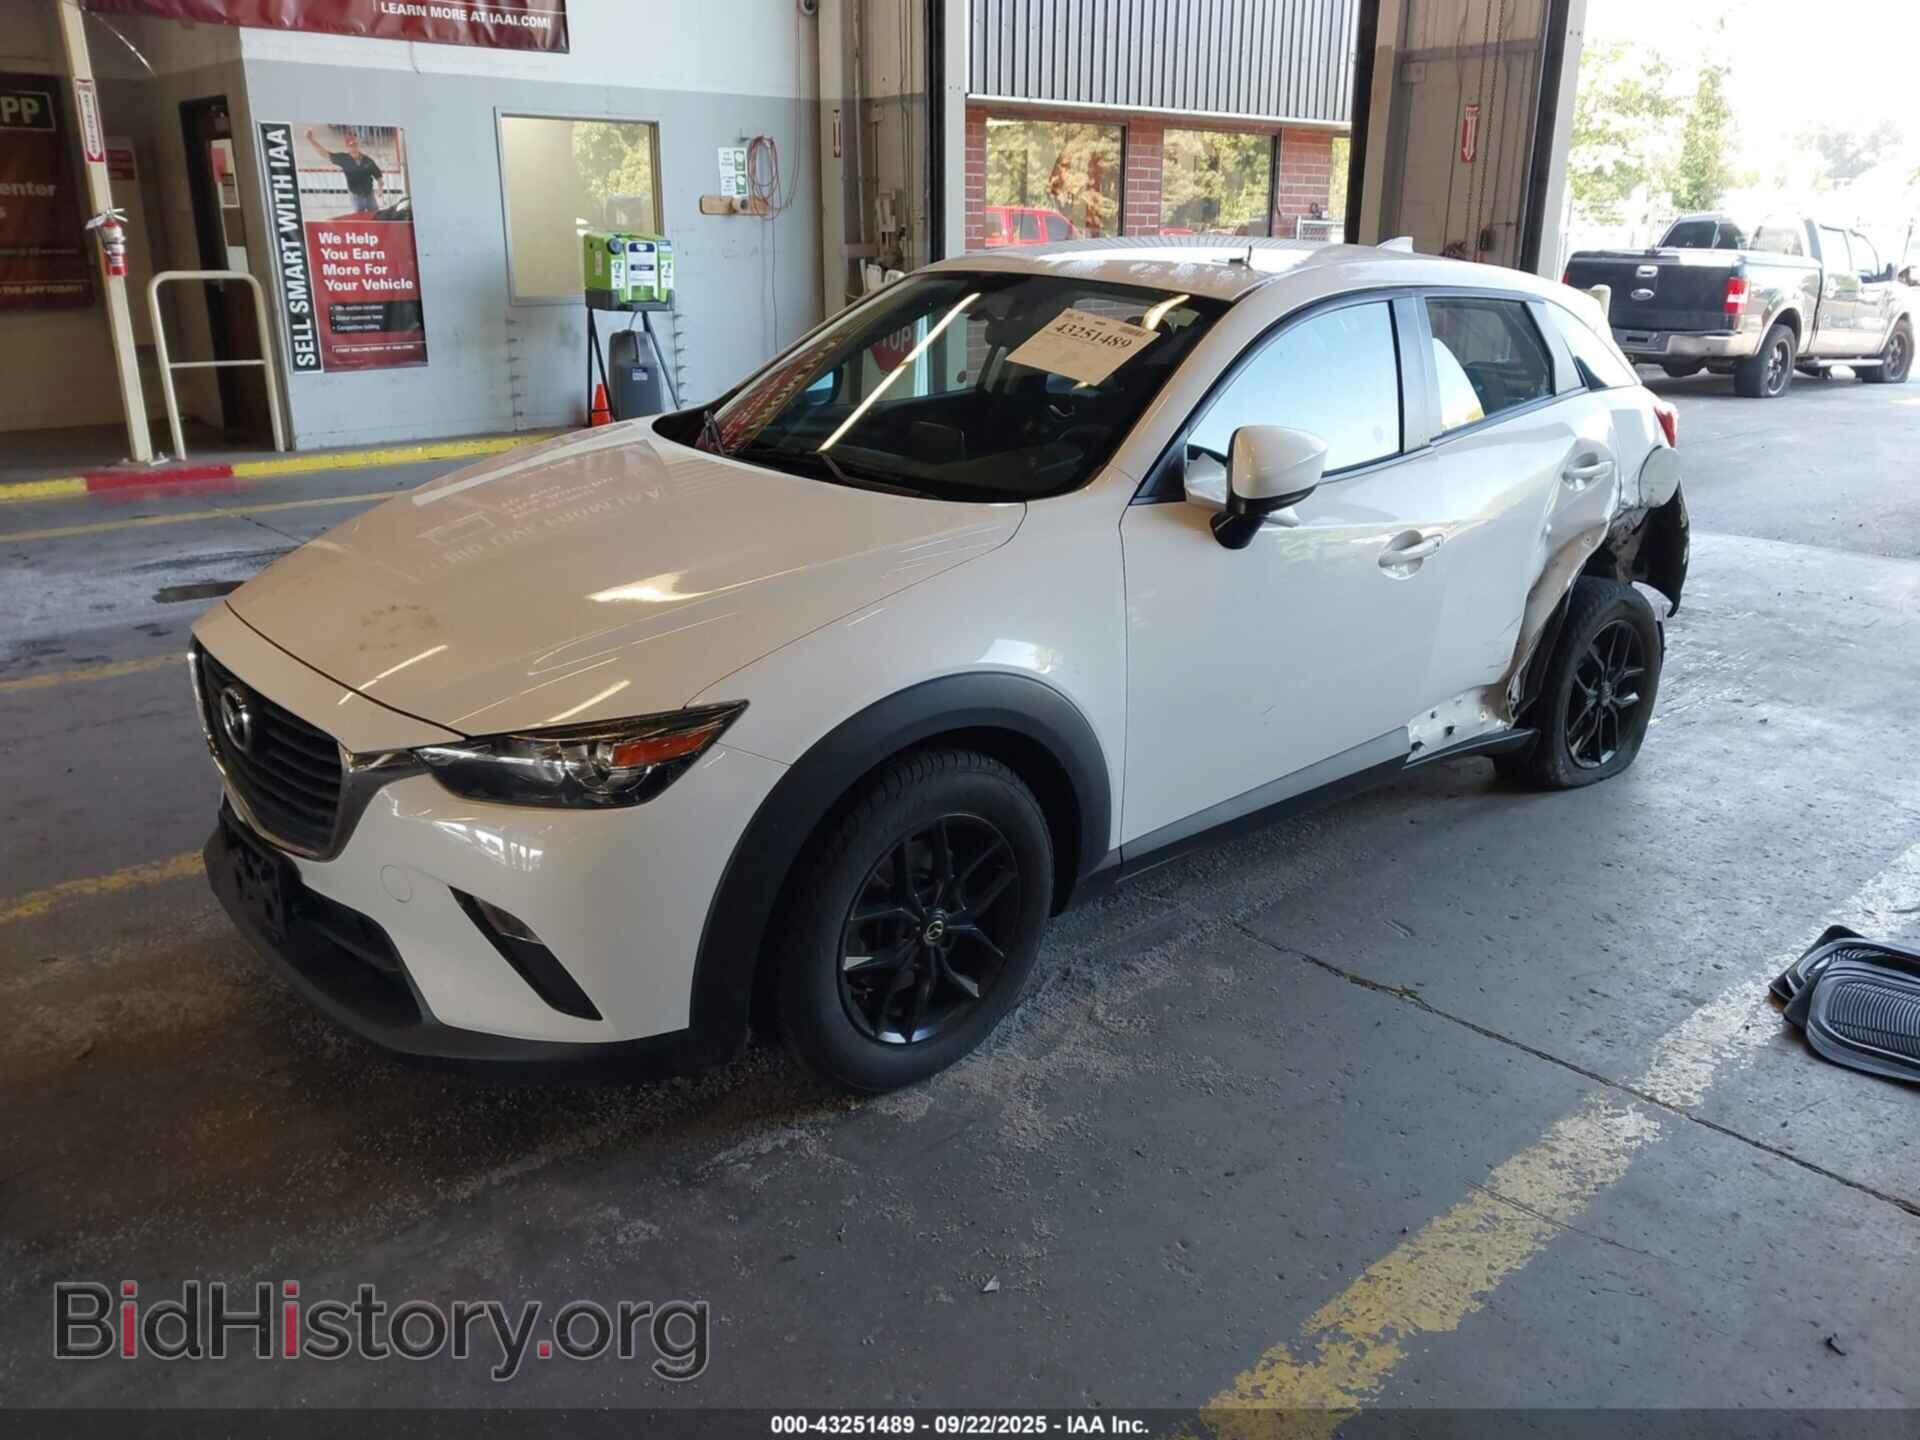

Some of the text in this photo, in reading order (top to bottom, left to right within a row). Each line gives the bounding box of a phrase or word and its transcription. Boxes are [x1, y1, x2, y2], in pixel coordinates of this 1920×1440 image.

[380, 2, 427, 17] LEARN
[430, 7, 466, 21] MORE
[470, 12, 487, 23] AT
[318, 232, 379, 247] We Help
[266, 128, 316, 368] SELL SMART WITH IAA
[320, 248, 385, 260] You Earn
[322, 263, 388, 276] More For
[324, 278, 414, 291] Your Vehicle
[1055, 322, 1133, 349] 43251489
